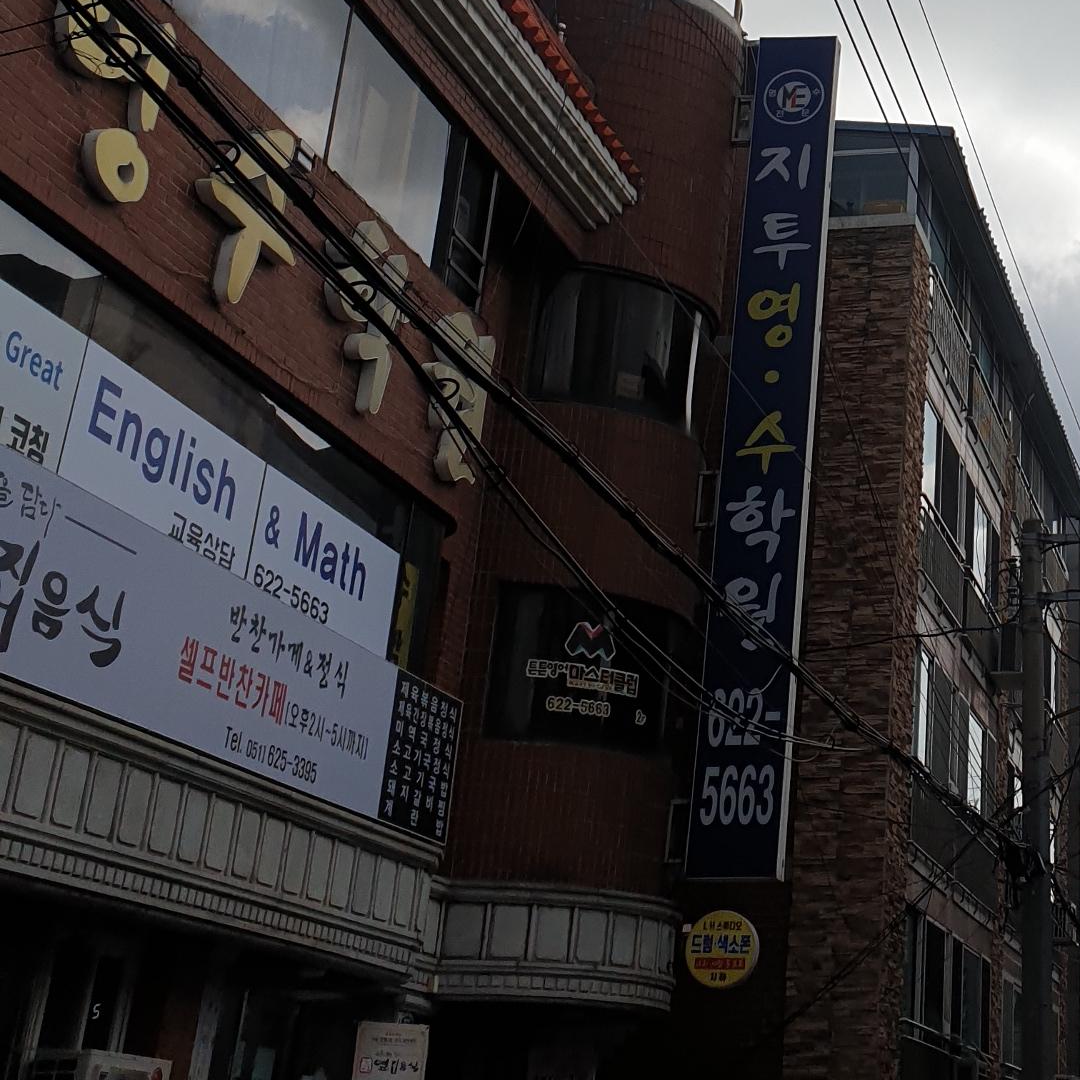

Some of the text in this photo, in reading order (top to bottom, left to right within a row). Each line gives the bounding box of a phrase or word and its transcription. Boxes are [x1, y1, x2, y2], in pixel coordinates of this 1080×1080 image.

[6, 331, 367, 601] Great English & Math
[168, 512, 236, 570] 교육상담
[253, 563, 330, 625] 622-5663
[546, 696, 610, 717] 622-5663
[224, 726, 242, 754] Tel.
[268, 745, 318, 784] 625-3395
[391, 739, 450, 779] 소고기국정식
[395, 720, 452, 760] 미역국정식
[699, 765, 776, 827] 5663
